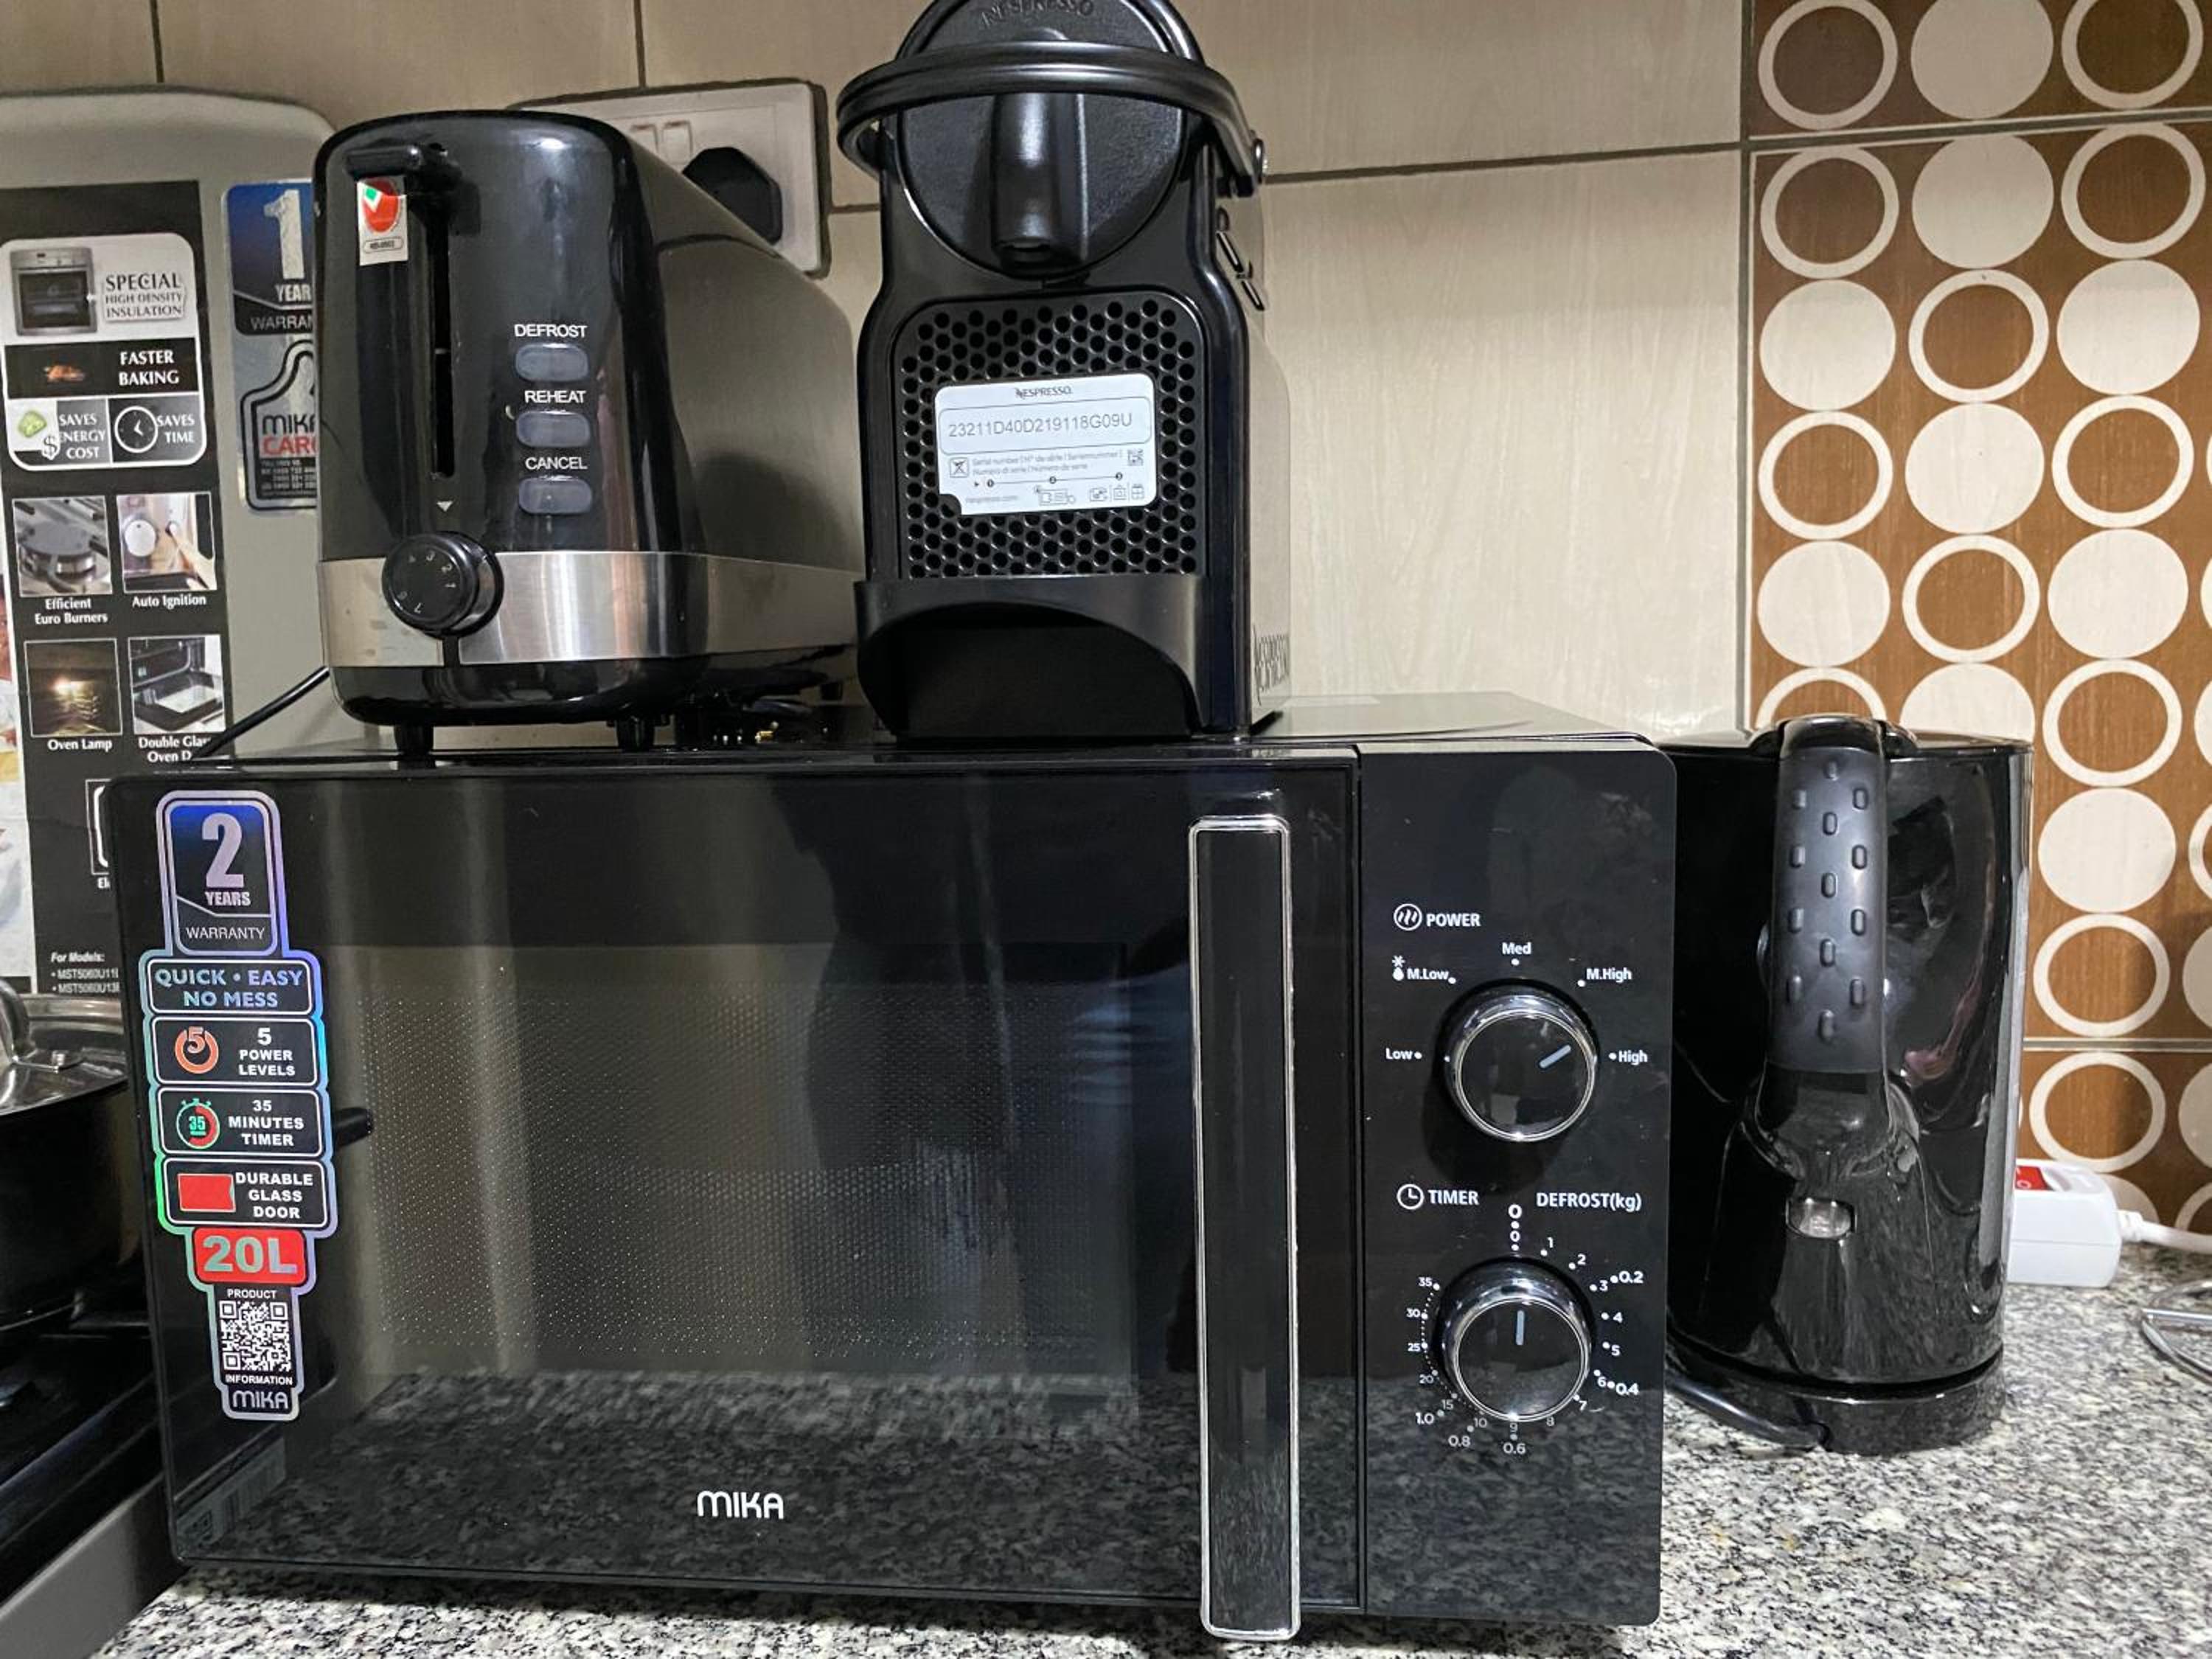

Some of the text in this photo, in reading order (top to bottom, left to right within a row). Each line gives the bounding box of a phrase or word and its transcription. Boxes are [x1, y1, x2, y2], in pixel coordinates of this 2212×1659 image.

[264, 189, 305, 279] 1
[105, 272, 181, 291] SPECIAL
[105, 292, 182, 304] HIGH DENSITY
[106, 305, 181, 317] INSULATION
[514, 324, 588, 338] DEFROST
[120, 349, 174, 365] FASTER
[119, 370, 179, 385] BAKING
[525, 390, 587, 403] REHEAT
[60, 414, 97, 425] SAVES
[156, 413, 195, 426] SAVES
[59, 430, 105, 442] ENERGY
[164, 431, 194, 442] TIME
[263, 436, 316, 455] CAR
[66, 447, 99, 459] COST
[526, 456, 588, 470] CANCEL
[46, 598, 91, 610] Efficient
[133, 594, 206, 609] Auto Ignition
[35, 613, 108, 625] Euro Burners
[48, 738, 112, 752] Oven Lamp
[139, 735, 180, 748] Double
[147, 751, 178, 762] Oven
[201, 812, 244, 888] 2
[205, 891, 251, 906] YEARS
[1426, 913, 1481, 928] POWER
[185, 926, 265, 940] WARRANTY
[1502, 942, 1531, 955] Med
[51, 951, 67, 962] For
[155, 968, 302, 987] QUICK EASY
[1407, 968, 1450, 980] M.Low
[1586, 967, 1632, 981] M.High
[184, 991, 278, 1008] NO MESS
[257, 1027, 272, 1046] 5
[239, 1049, 293, 1061] POWER
[1385, 1048, 1413, 1060] Low
[1618, 1050, 1648, 1065] High
[239, 1063, 296, 1077] LEVELS
[252, 1100, 272, 1112] 35
[189, 1116, 206, 1130] 35
[228, 1116, 305, 1130] MINUTES
[241, 1133, 294, 1147] TIMER
[235, 1172, 313, 1186] DURABLE
[248, 1189, 302, 1203] GLASS
[1428, 1189, 1479, 1206] TIMER
[1536, 1192, 1642, 1211] DEFROST(kg)
[253, 1206, 300, 1219] DOOR
[1508, 1204, 1522, 1219] 0
[1547, 1237, 1554, 1248] 1
[203, 1235, 297, 1273] 20L
[1576, 1254, 1586, 1265] 2
[1418, 1277, 1433, 1287] 35
[1618, 1271, 1644, 1283] 0.2
[1599, 1281, 1608, 1292] 3
[227, 1289, 277, 1299] PRODUCT
[1406, 1308, 1421, 1318] 30
[1613, 1312, 1623, 1322] 4
[1408, 1343, 1421, 1352] 25
[1611, 1345, 1620, 1356] 5
[226, 1374, 293, 1385] INFORMATION
[1419, 1374, 1434, 1384] 20
[1597, 1377, 1606, 1387] 6
[1615, 1383, 1639, 1396] 0.4
[232, 1391, 289, 1409] MIKA
[1441, 1399, 1454, 1410] 15
[1579, 1400, 1587, 1411] 7
[1415, 1413, 1434, 1424] 1.0
[1475, 1417, 1487, 1428] 10
[1546, 1416, 1554, 1427] 8
[1509, 1422, 1518, 1433] 9
[1448, 1436, 1471, 1447] 0.8
[1503, 1443, 1526, 1455] 0.6
[697, 1490, 784, 1520] MIKA
